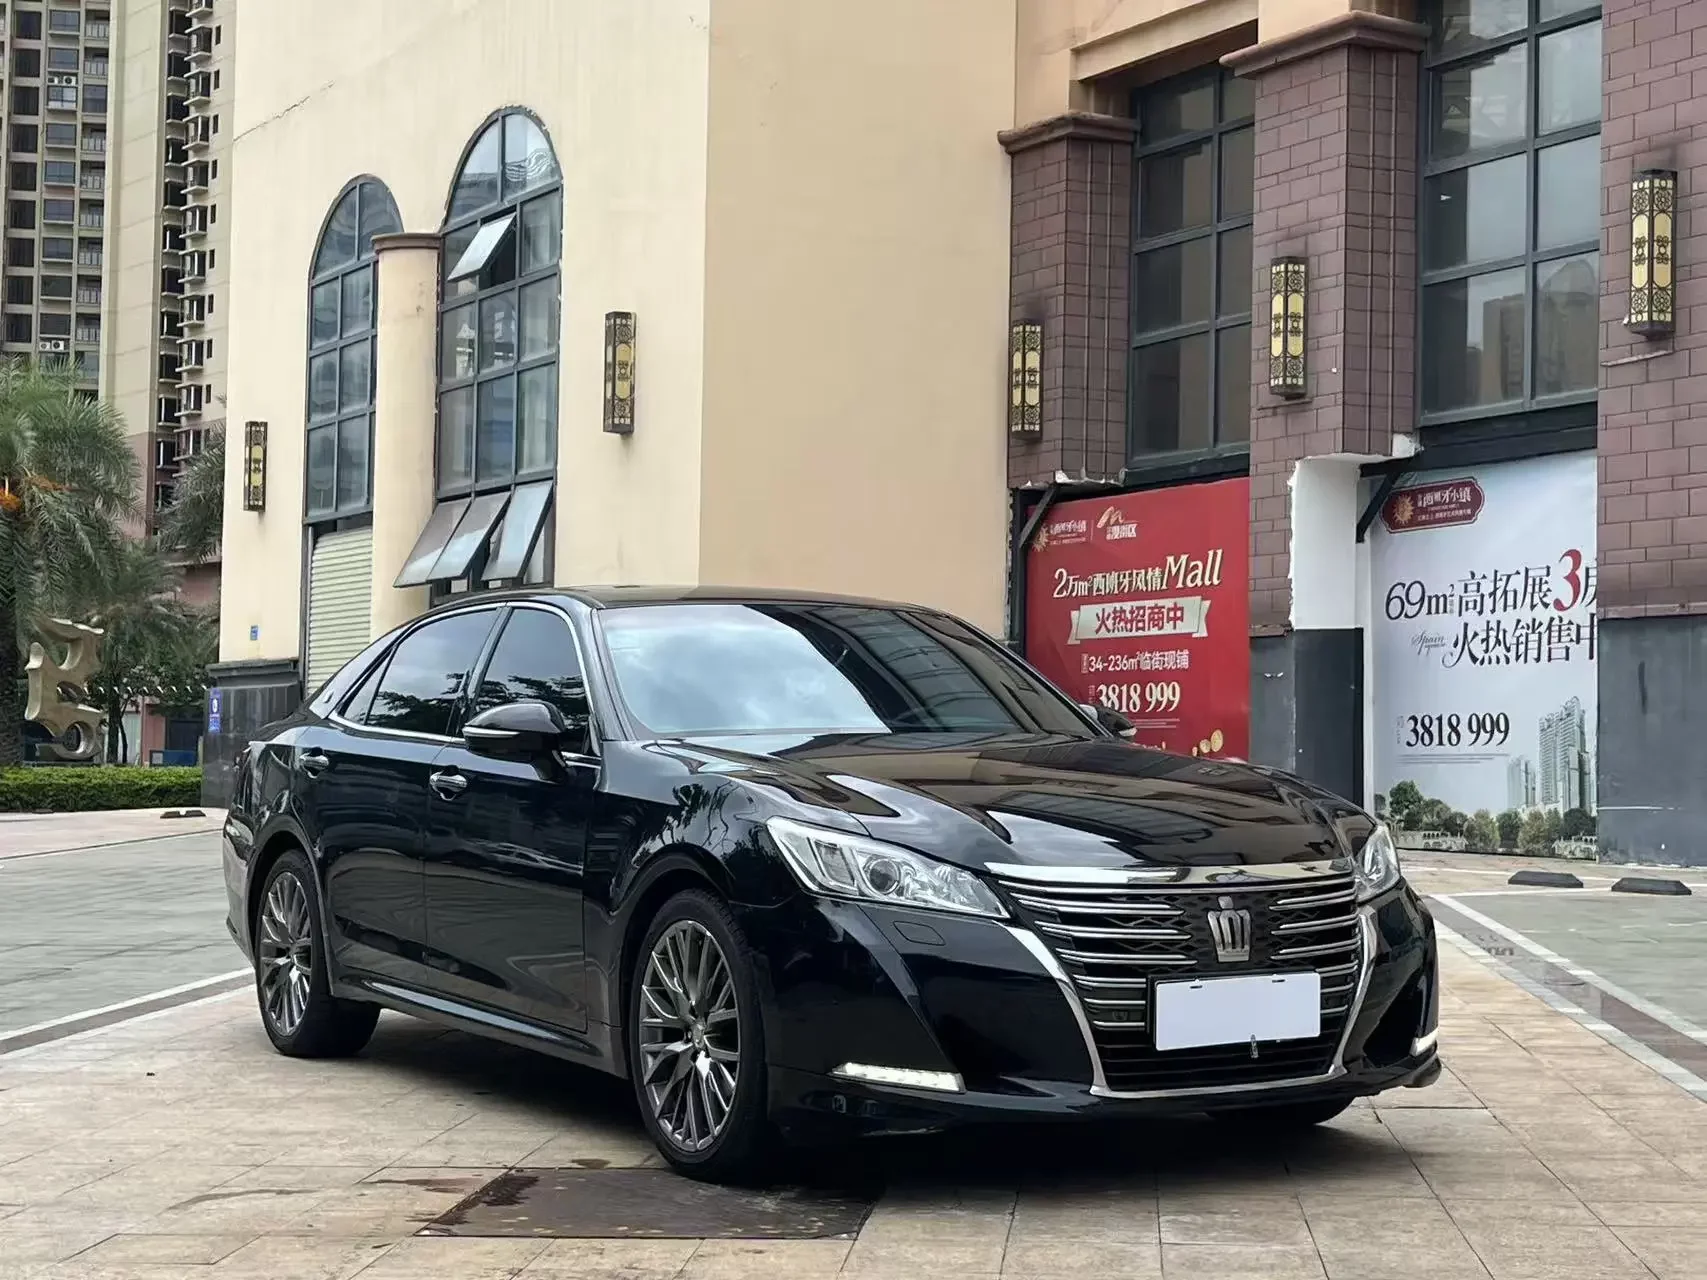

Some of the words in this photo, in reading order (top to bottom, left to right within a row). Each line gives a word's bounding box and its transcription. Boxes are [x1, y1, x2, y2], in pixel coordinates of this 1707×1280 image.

[1094, 602, 1185, 635] 火热招商中
[1441, 612, 1597, 668] 火热销售中
[1144, 681, 1181, 713] 999
[1405, 713, 1461, 747] 3818
[1467, 712, 1510, 747] 999
